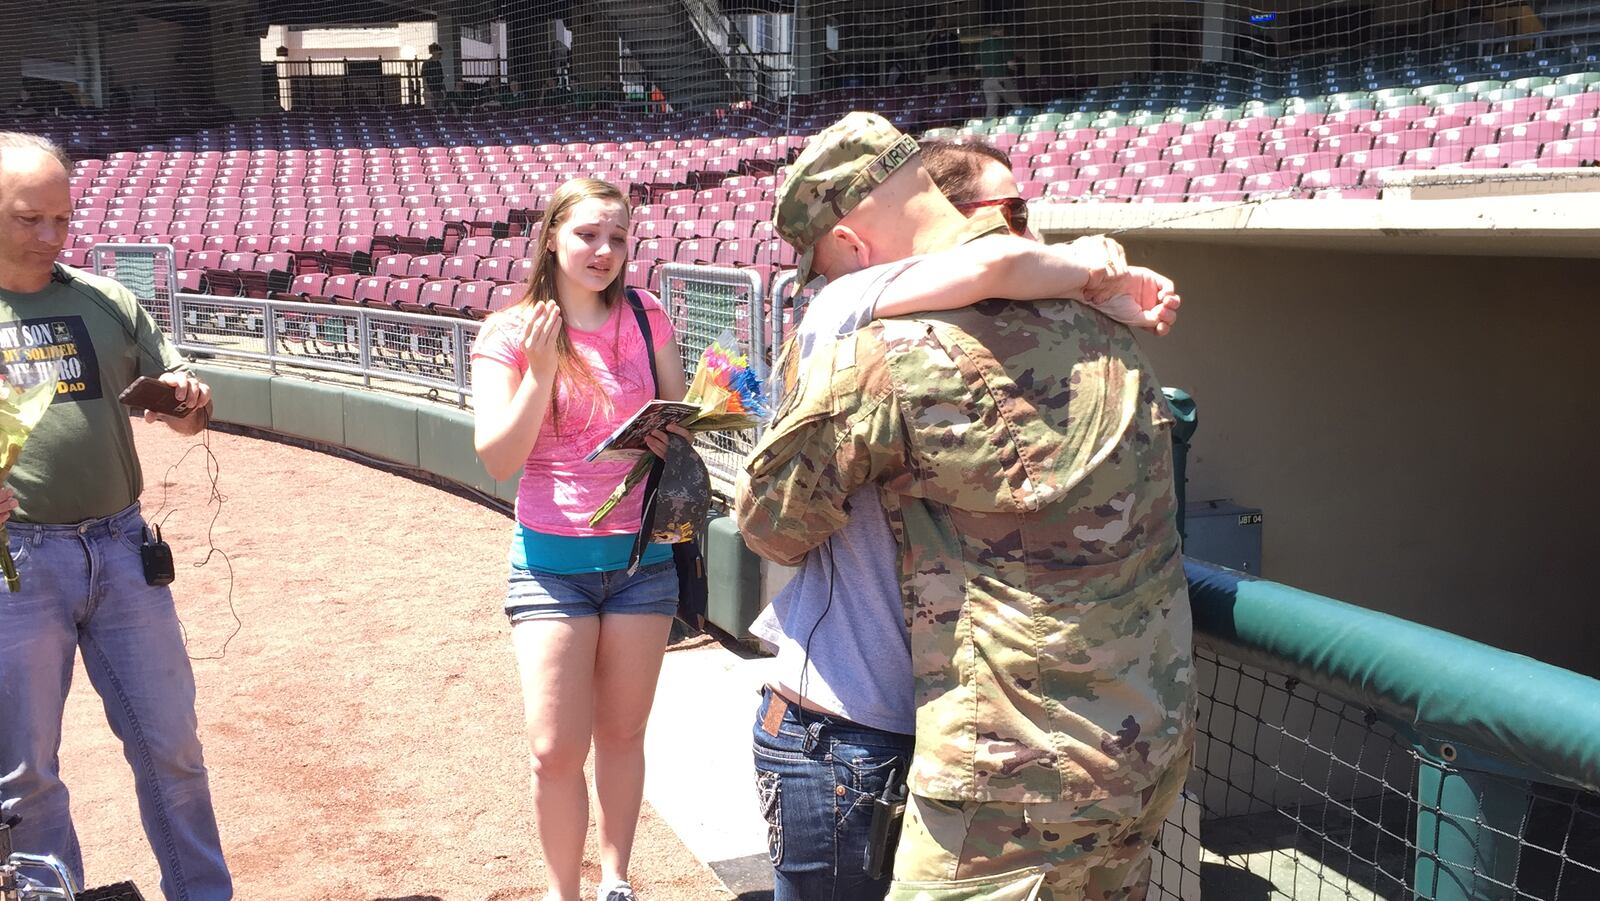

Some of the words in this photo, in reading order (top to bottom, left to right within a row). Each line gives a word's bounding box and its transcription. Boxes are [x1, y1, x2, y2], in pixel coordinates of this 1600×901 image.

[0, 327, 20, 348] MY
[21, 323, 53, 346] SON
[3, 349, 20, 362] MY
[24, 343, 77, 361] SOLDIER
[6, 363, 30, 384] MY
[1253, 515, 1262, 523] 04
